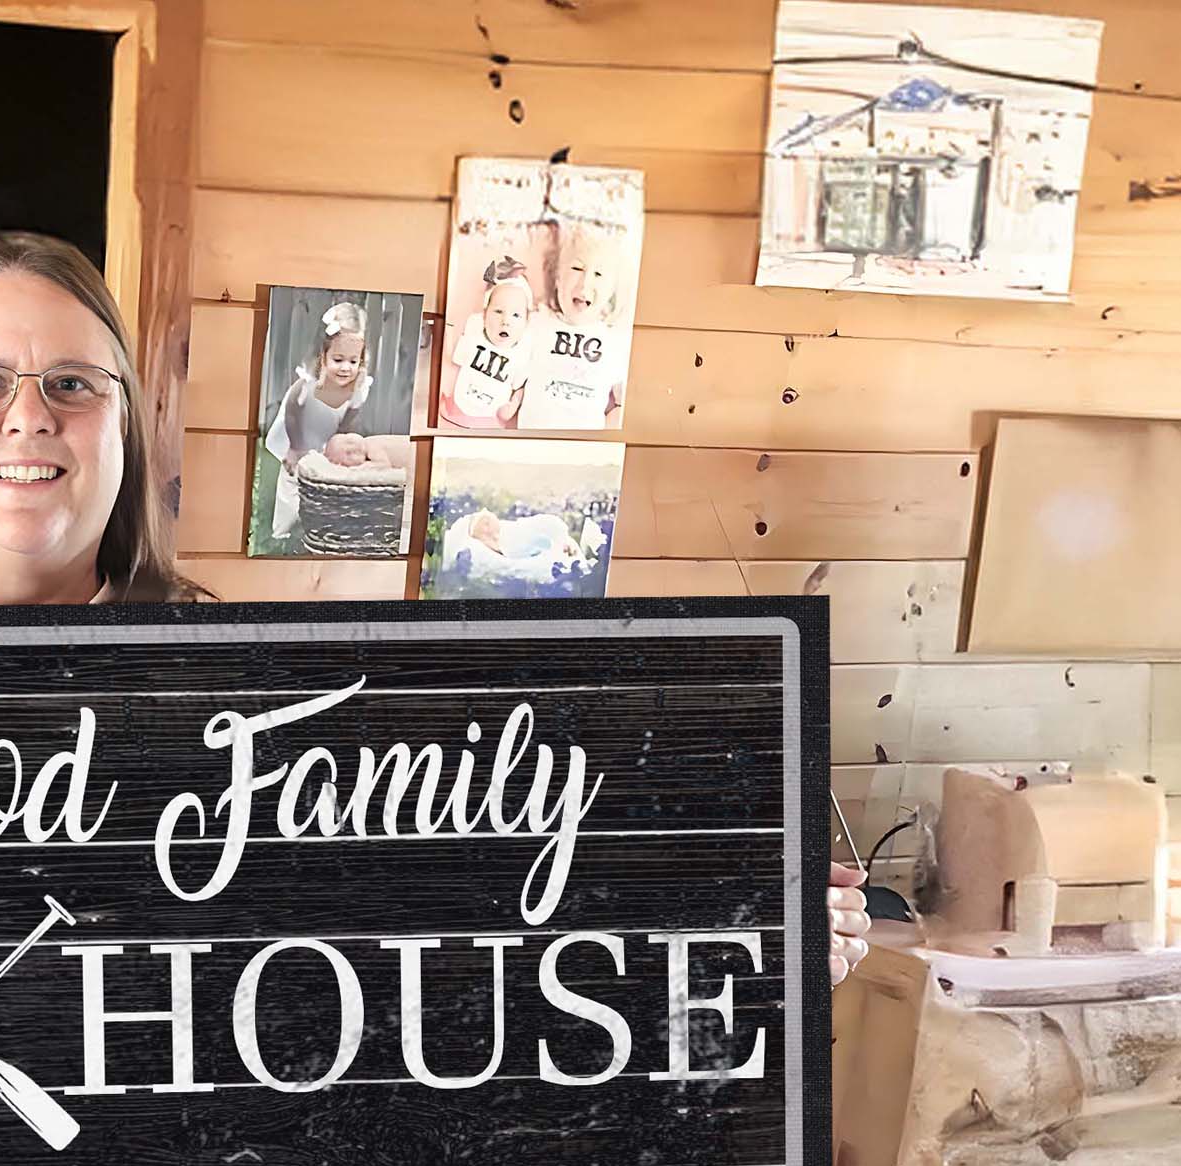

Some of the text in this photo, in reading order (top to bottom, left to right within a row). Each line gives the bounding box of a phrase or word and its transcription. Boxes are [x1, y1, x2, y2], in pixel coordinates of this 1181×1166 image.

[469, 345, 510, 382] LIL
[551, 331, 603, 363] BIG
[155, 674, 604, 925] Family
[62, 931, 766, 1096] HOUSE
